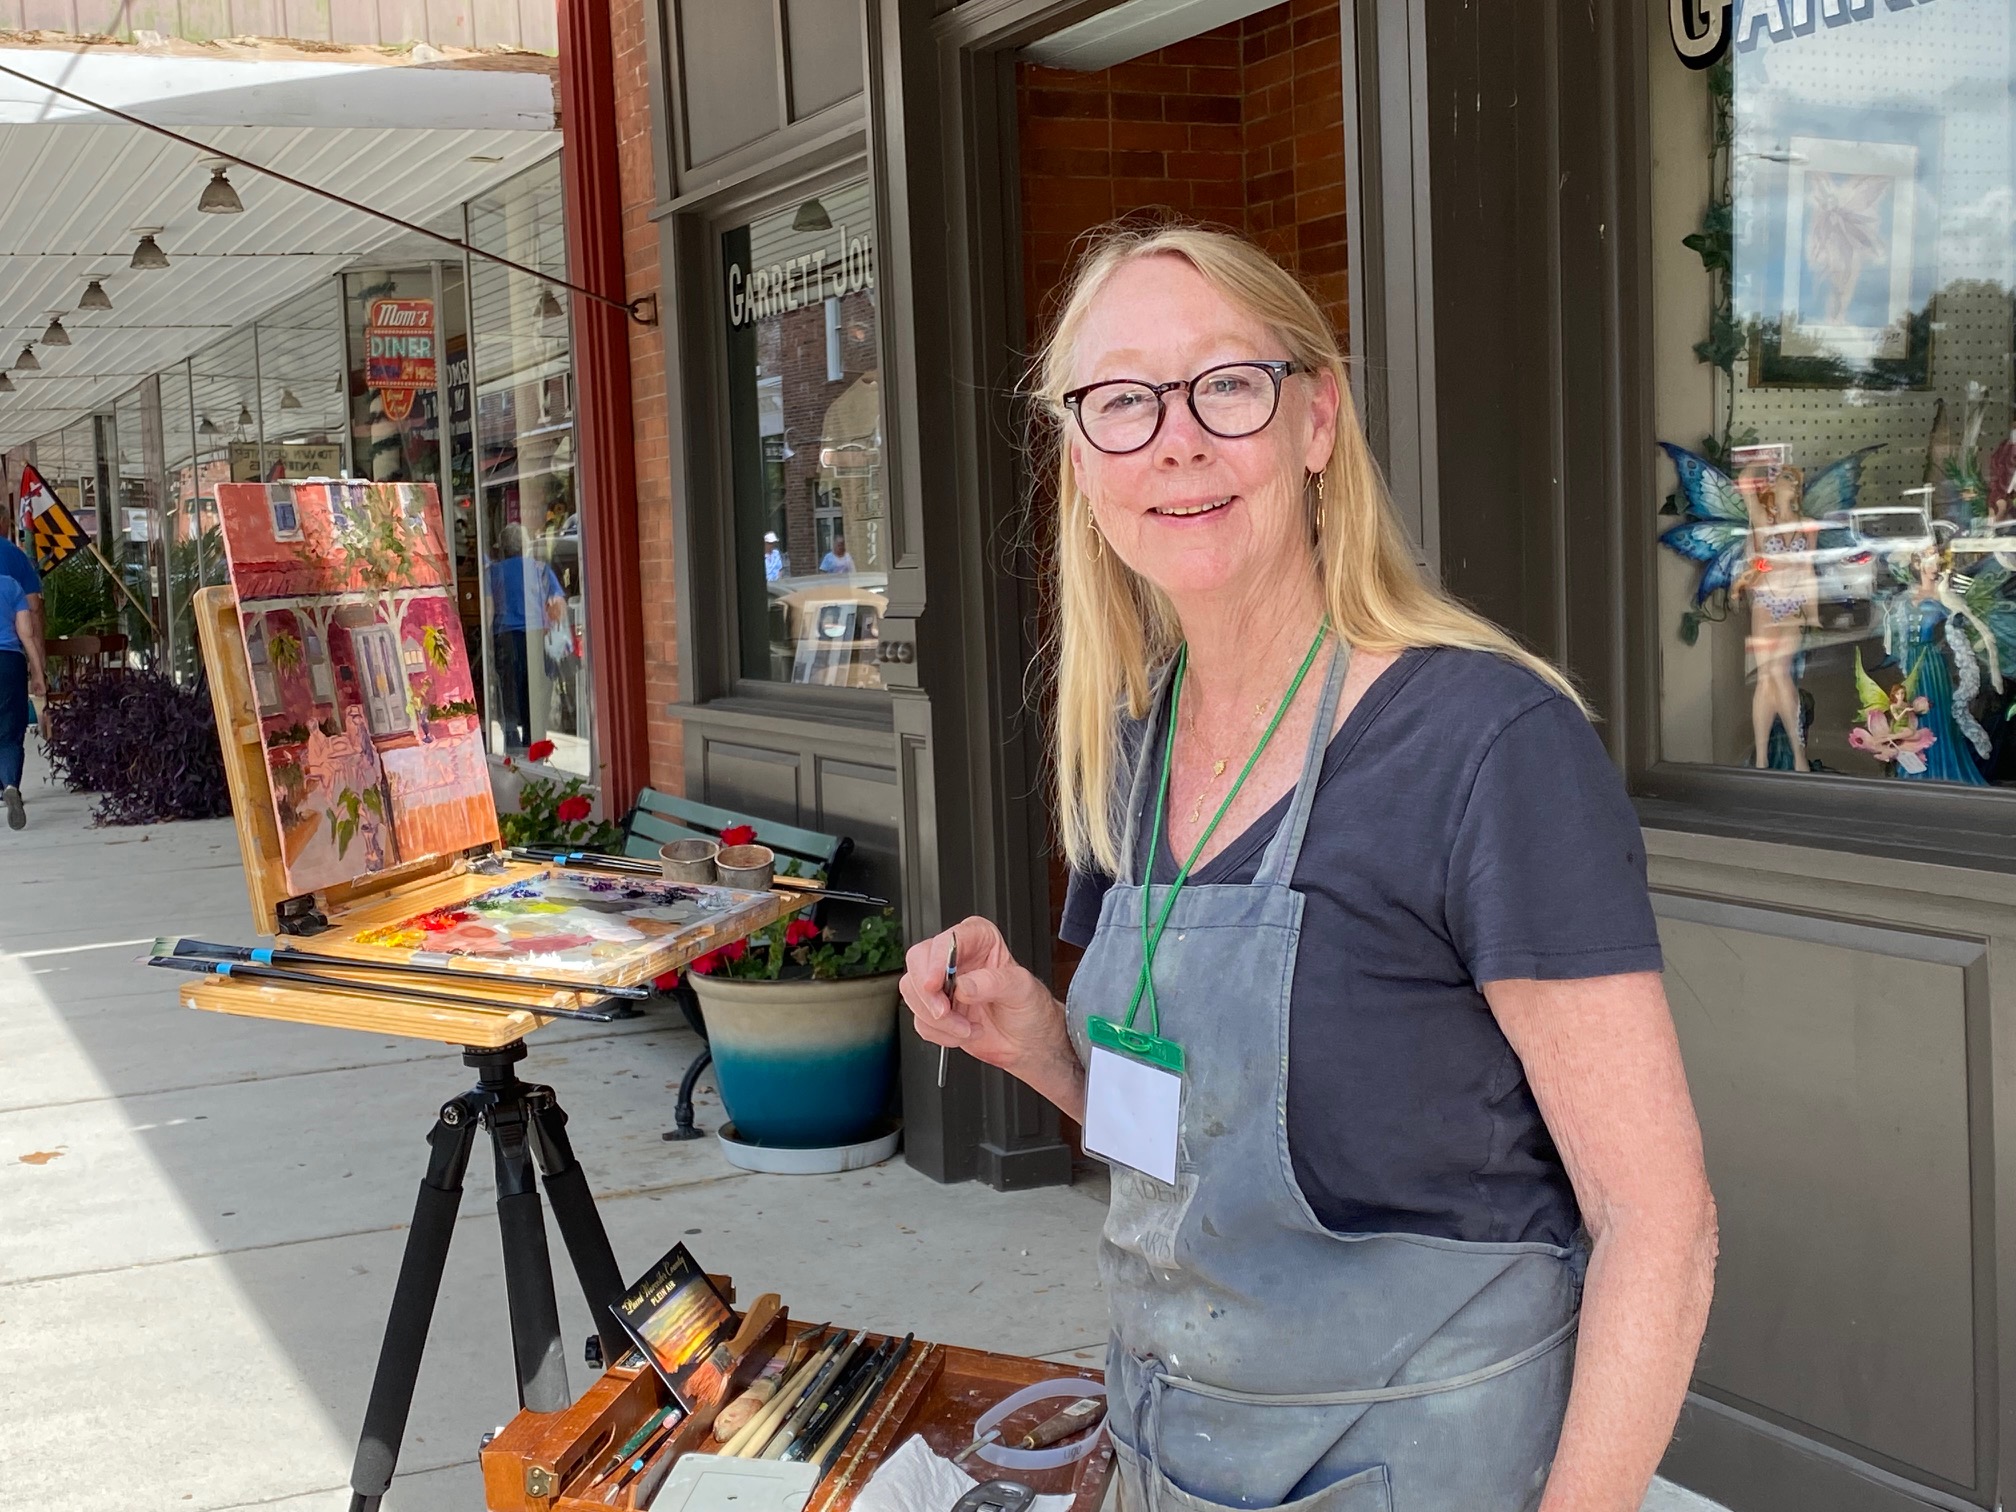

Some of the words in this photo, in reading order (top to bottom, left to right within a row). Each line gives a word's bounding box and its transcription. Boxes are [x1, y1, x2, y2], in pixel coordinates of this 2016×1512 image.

[728, 249, 827, 327] GARRETT
[377, 304, 429, 327] Mom's
[370, 336, 431, 358] DINER
[650, 1288, 667, 1307] PLEIN
[664, 1279, 677, 1293] AIR
